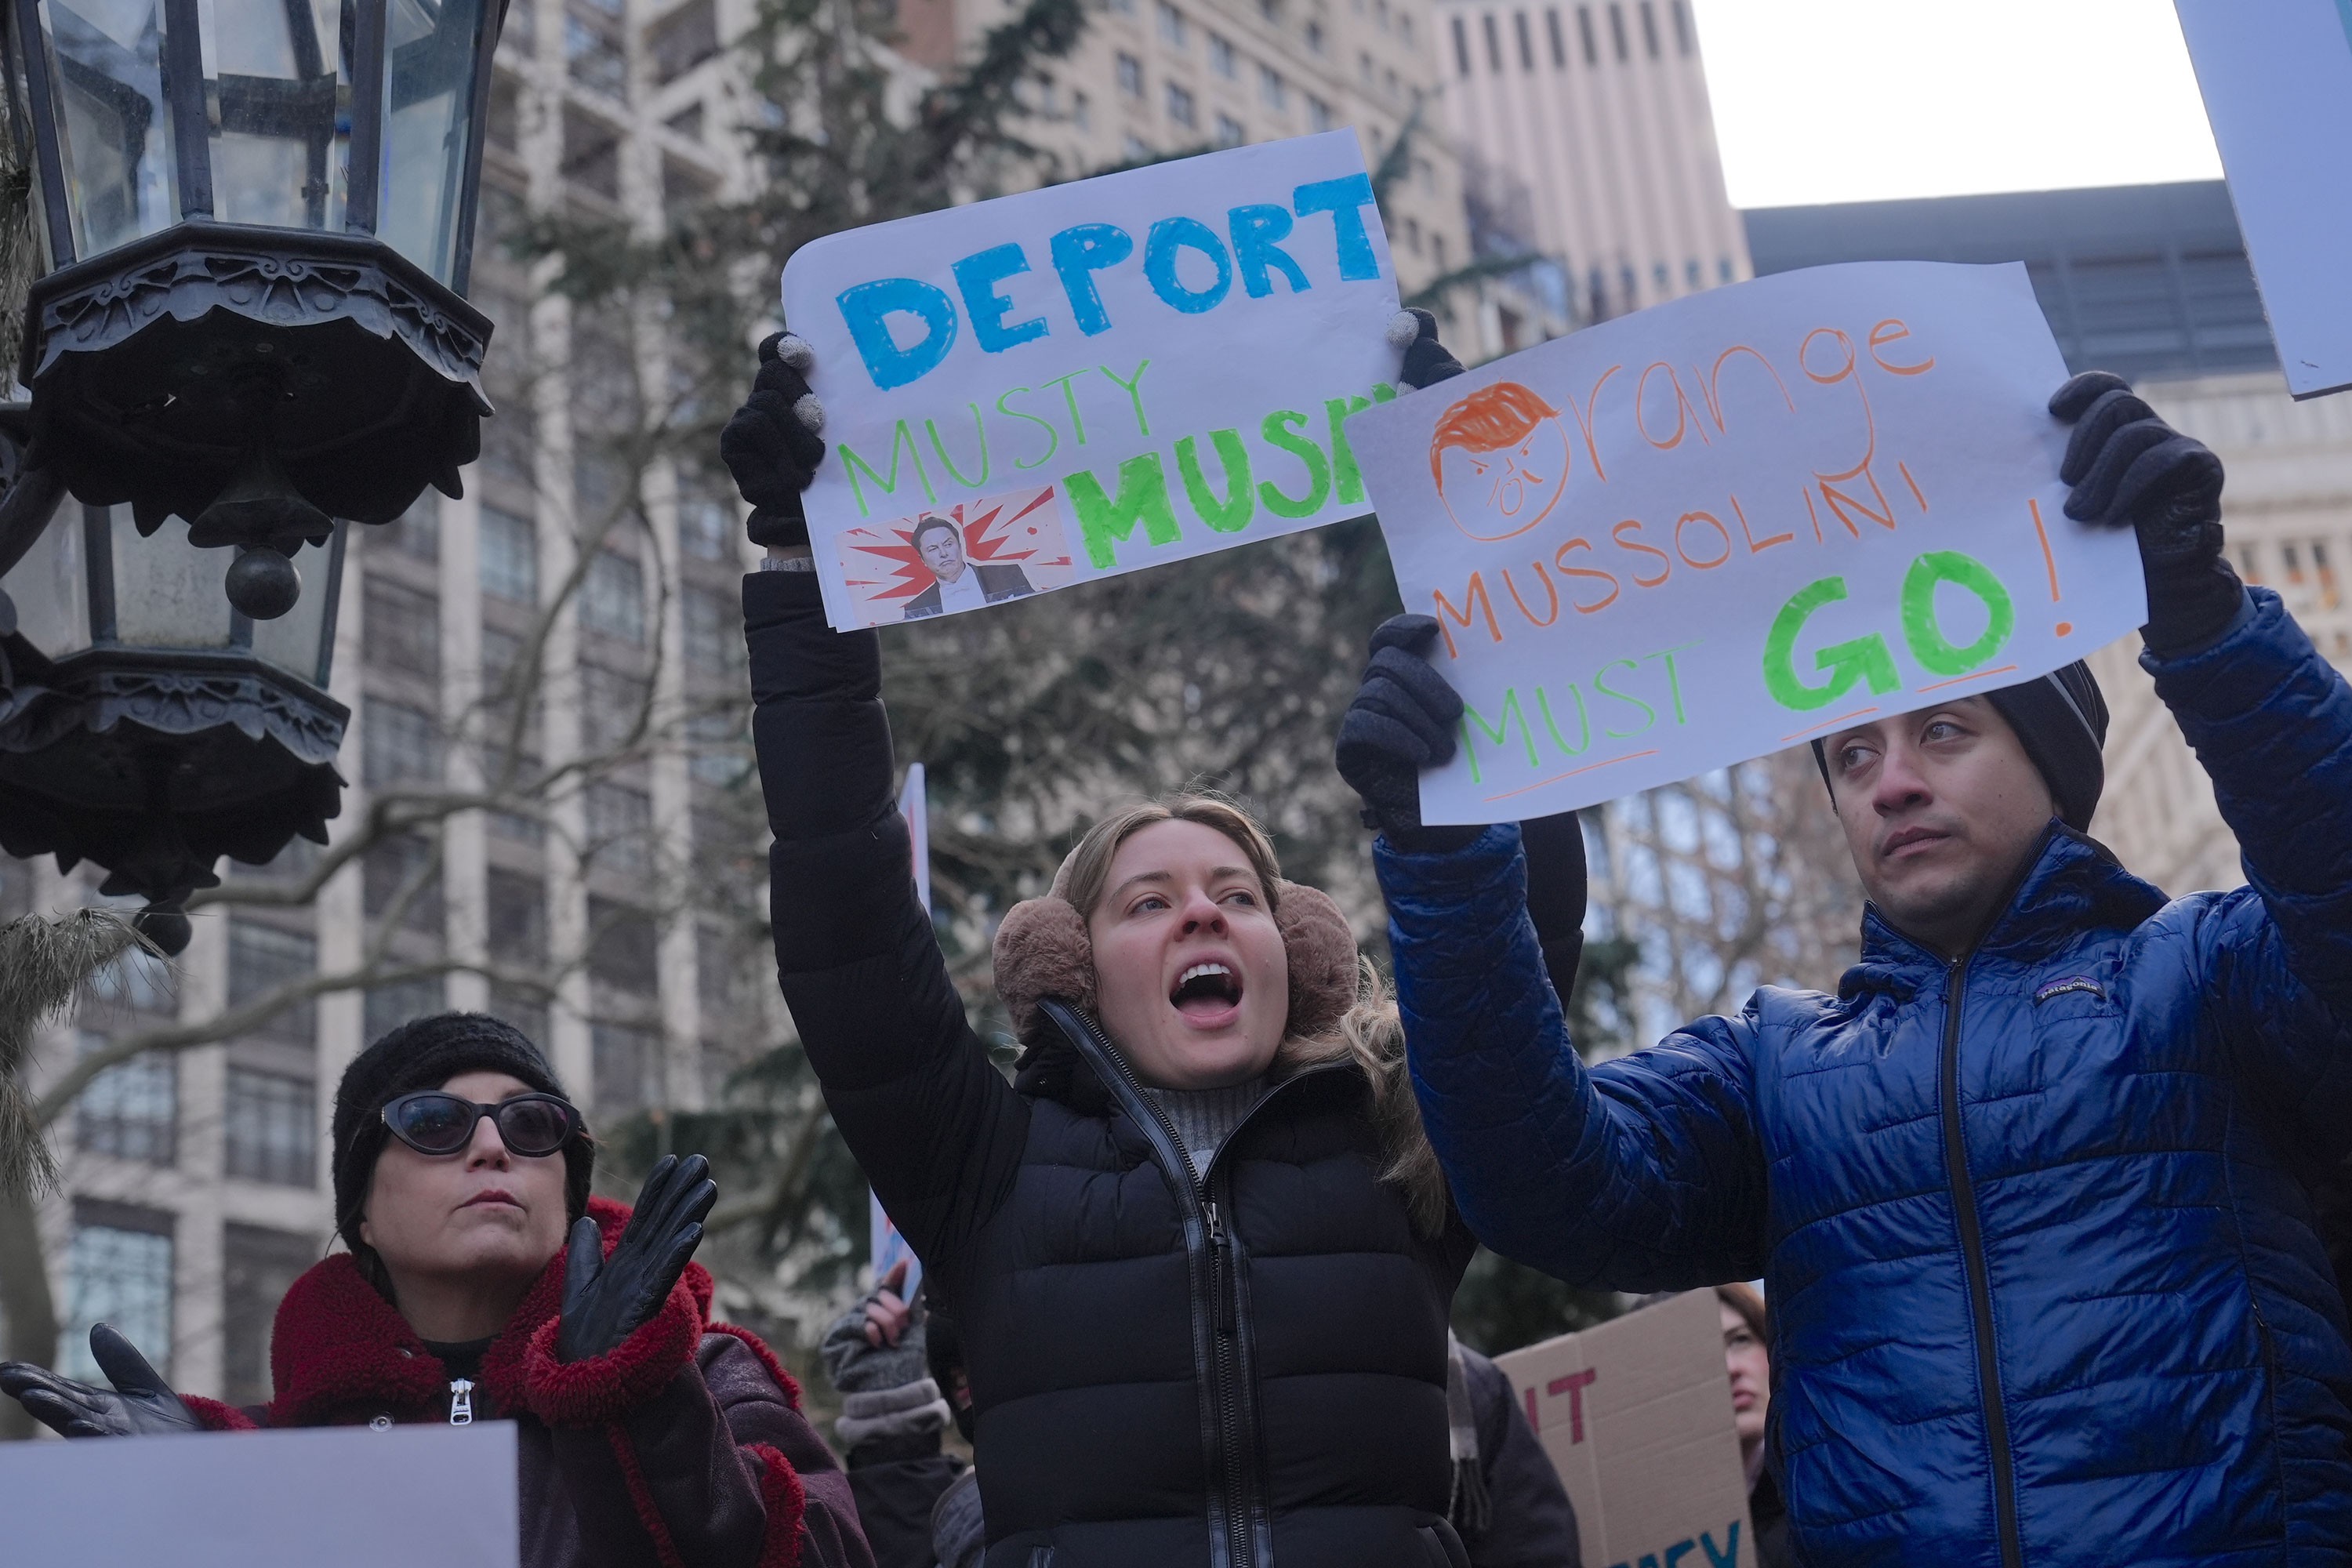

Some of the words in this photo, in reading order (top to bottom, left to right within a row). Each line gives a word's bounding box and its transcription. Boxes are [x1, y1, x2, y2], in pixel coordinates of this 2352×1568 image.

[835, 172, 1381, 392] DEPORT
[837, 359, 1151, 518] MUSTY
[1432, 459, 1929, 659] MUSSOLINI
[1461, 638, 1704, 784] MUST
[2039, 981, 2098, 999] patagonia
